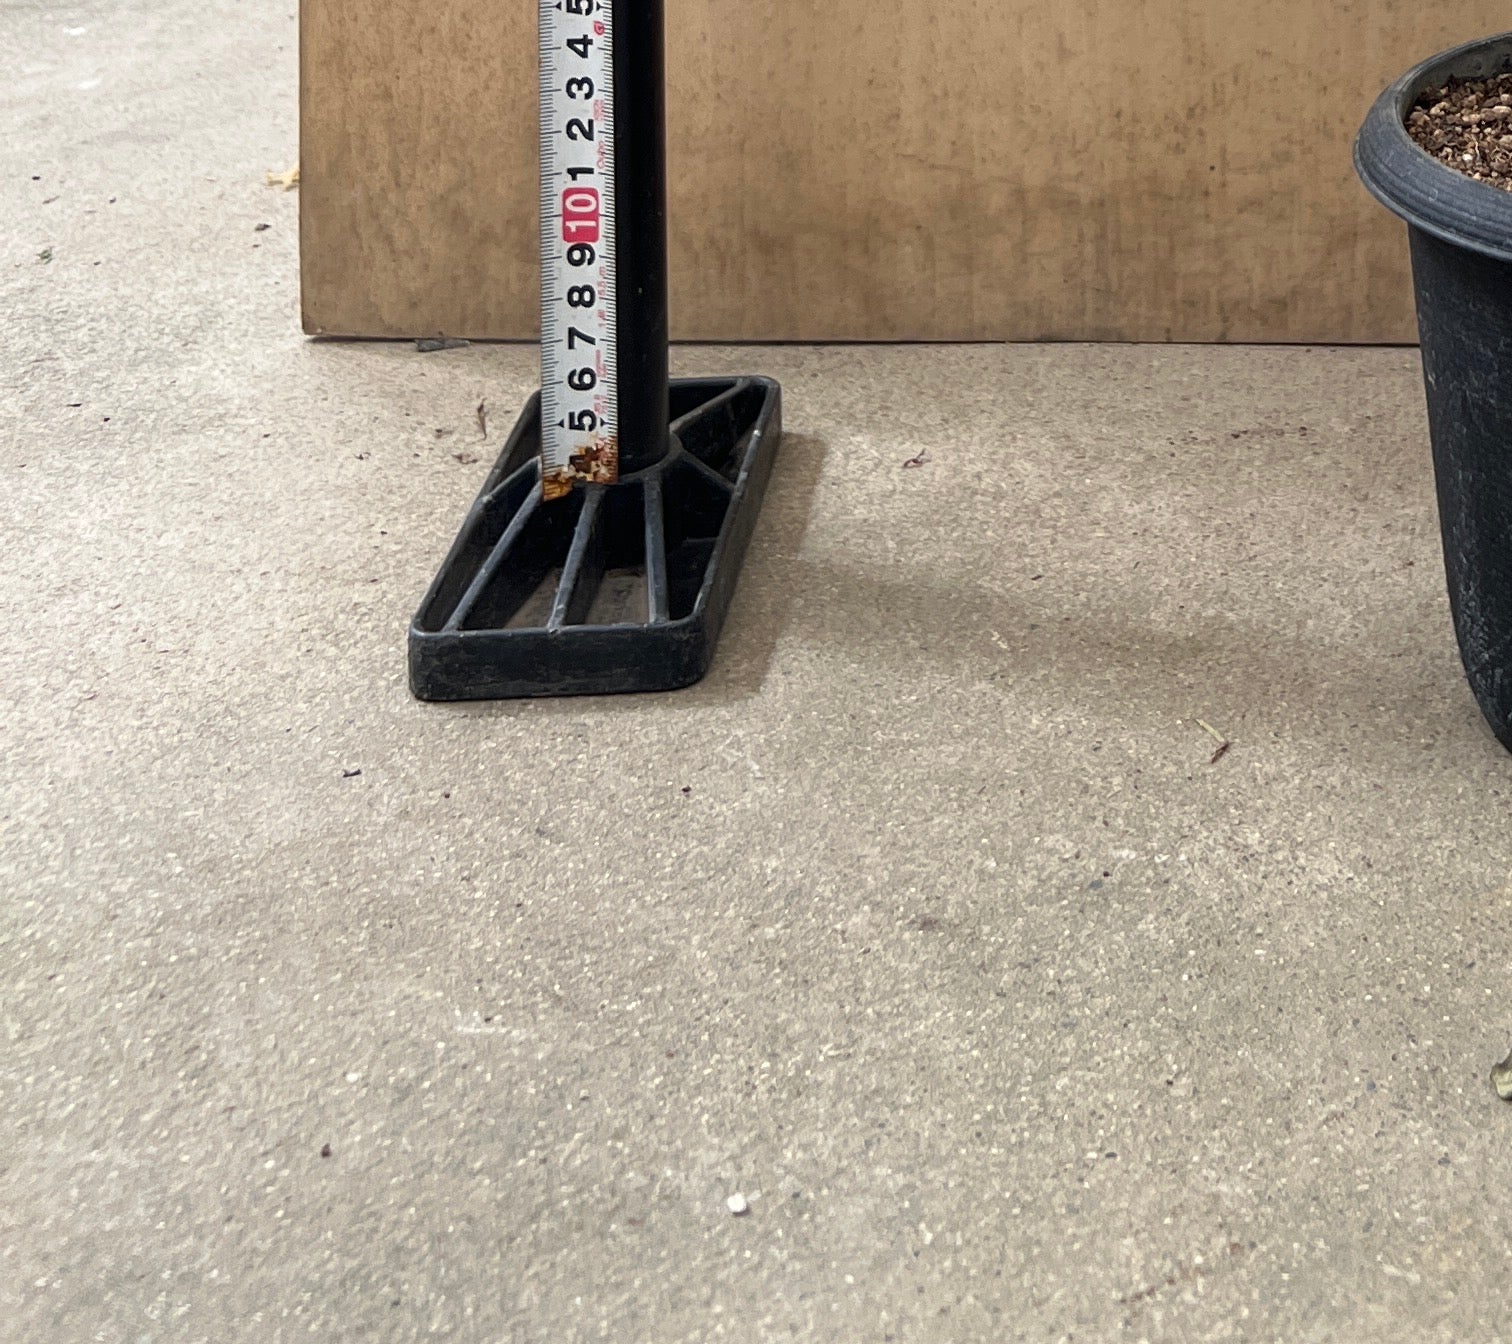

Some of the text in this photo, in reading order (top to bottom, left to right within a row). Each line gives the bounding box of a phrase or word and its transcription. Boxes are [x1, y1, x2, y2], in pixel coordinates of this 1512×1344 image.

[566, 34, 594, 59] 4
[565, 76, 594, 100] 3
[565, 118, 594, 142] 2
[566, 167, 595, 181] 1
[565, 193, 596, 232] 10
[566, 243, 596, 267] 9
[566, 284, 596, 309] 8
[567, 326, 596, 350] 7
[567, 367, 597, 392] 6
[568, 409, 597, 433] 5
